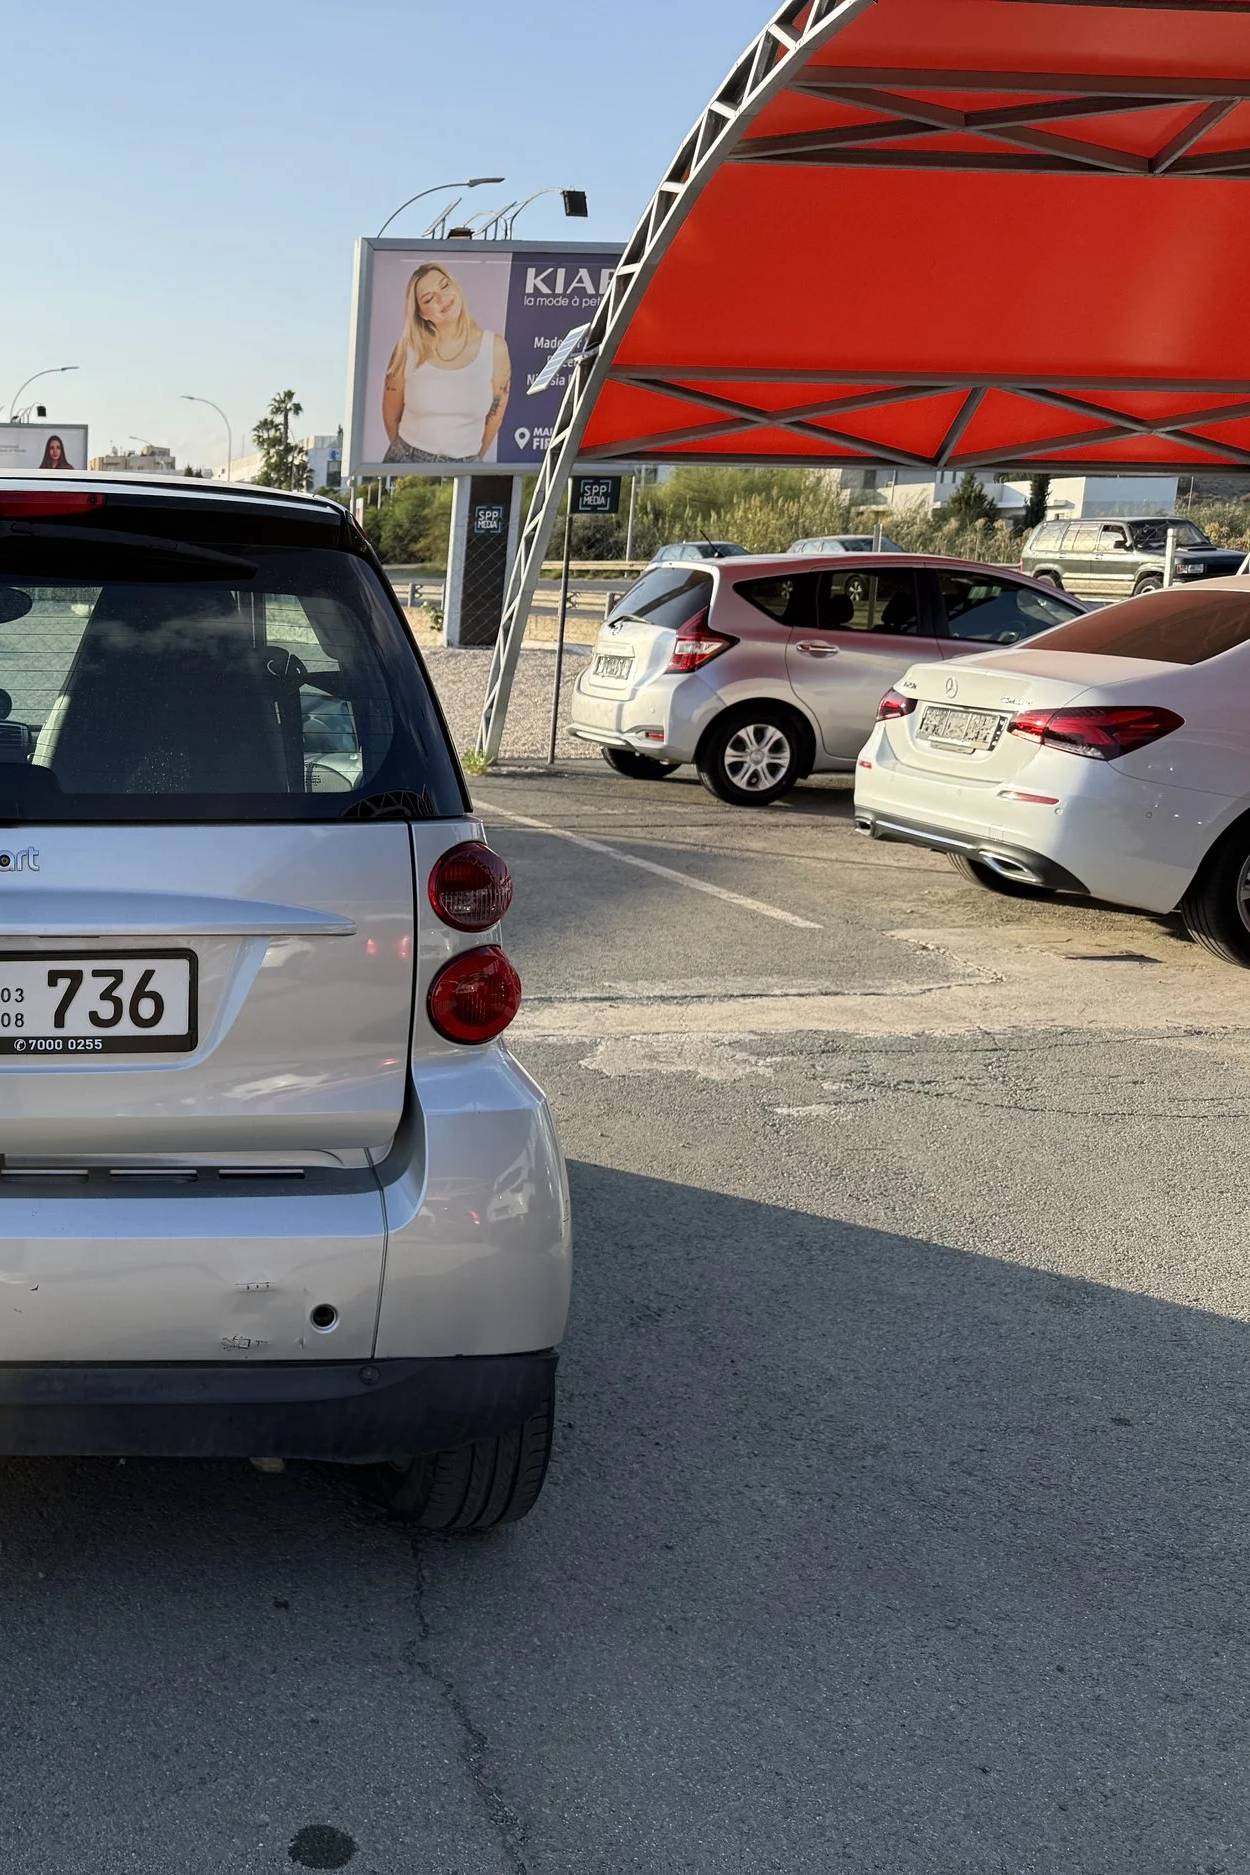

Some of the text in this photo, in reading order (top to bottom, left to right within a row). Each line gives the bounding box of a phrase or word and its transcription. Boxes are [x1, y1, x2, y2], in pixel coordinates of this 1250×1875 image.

[524, 296, 534, 306] la
[536, 296, 569, 306] mode
[584, 485, 607, 496] SPP
[583, 496, 605, 505] MEDIA
[478, 511, 499, 521] SPP
[477, 520, 498, 529] MEDIA
[0, 987, 25, 1003] 03
[47, 969, 165, 1029] 736
[0, 1012, 25, 1028] 08
[28, 1039, 63, 1050] 7000
[67, 1039, 103, 1050] 0255
